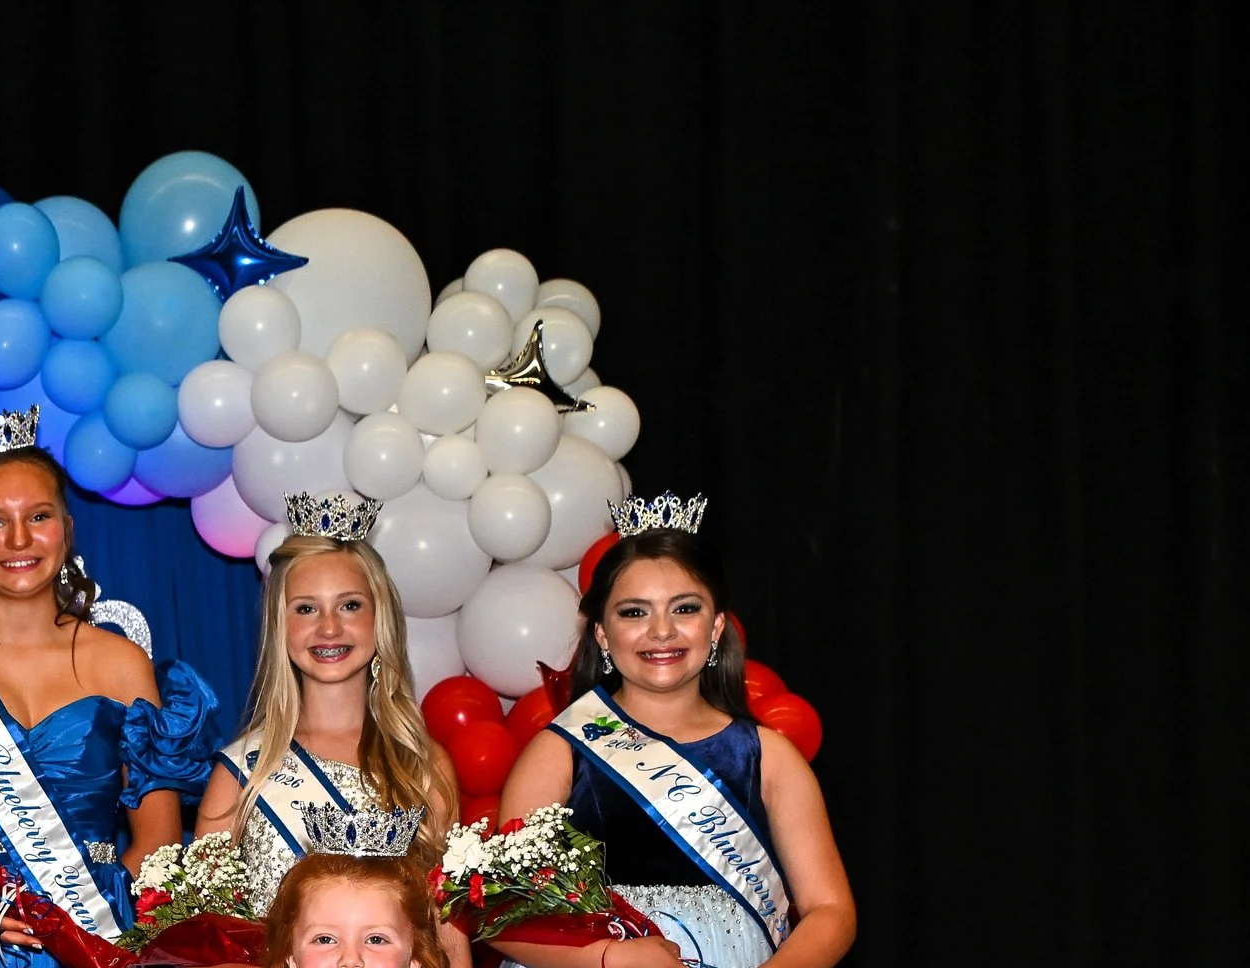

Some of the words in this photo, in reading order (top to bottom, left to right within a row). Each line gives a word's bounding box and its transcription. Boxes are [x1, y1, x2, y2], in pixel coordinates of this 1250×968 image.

[604, 739, 647, 752] 2026
[268, 770, 305, 789] 2026
[635, 761, 702, 802] NC
[688, 805, 777, 917] Blueberry
[54, 866, 98, 932] Youn
